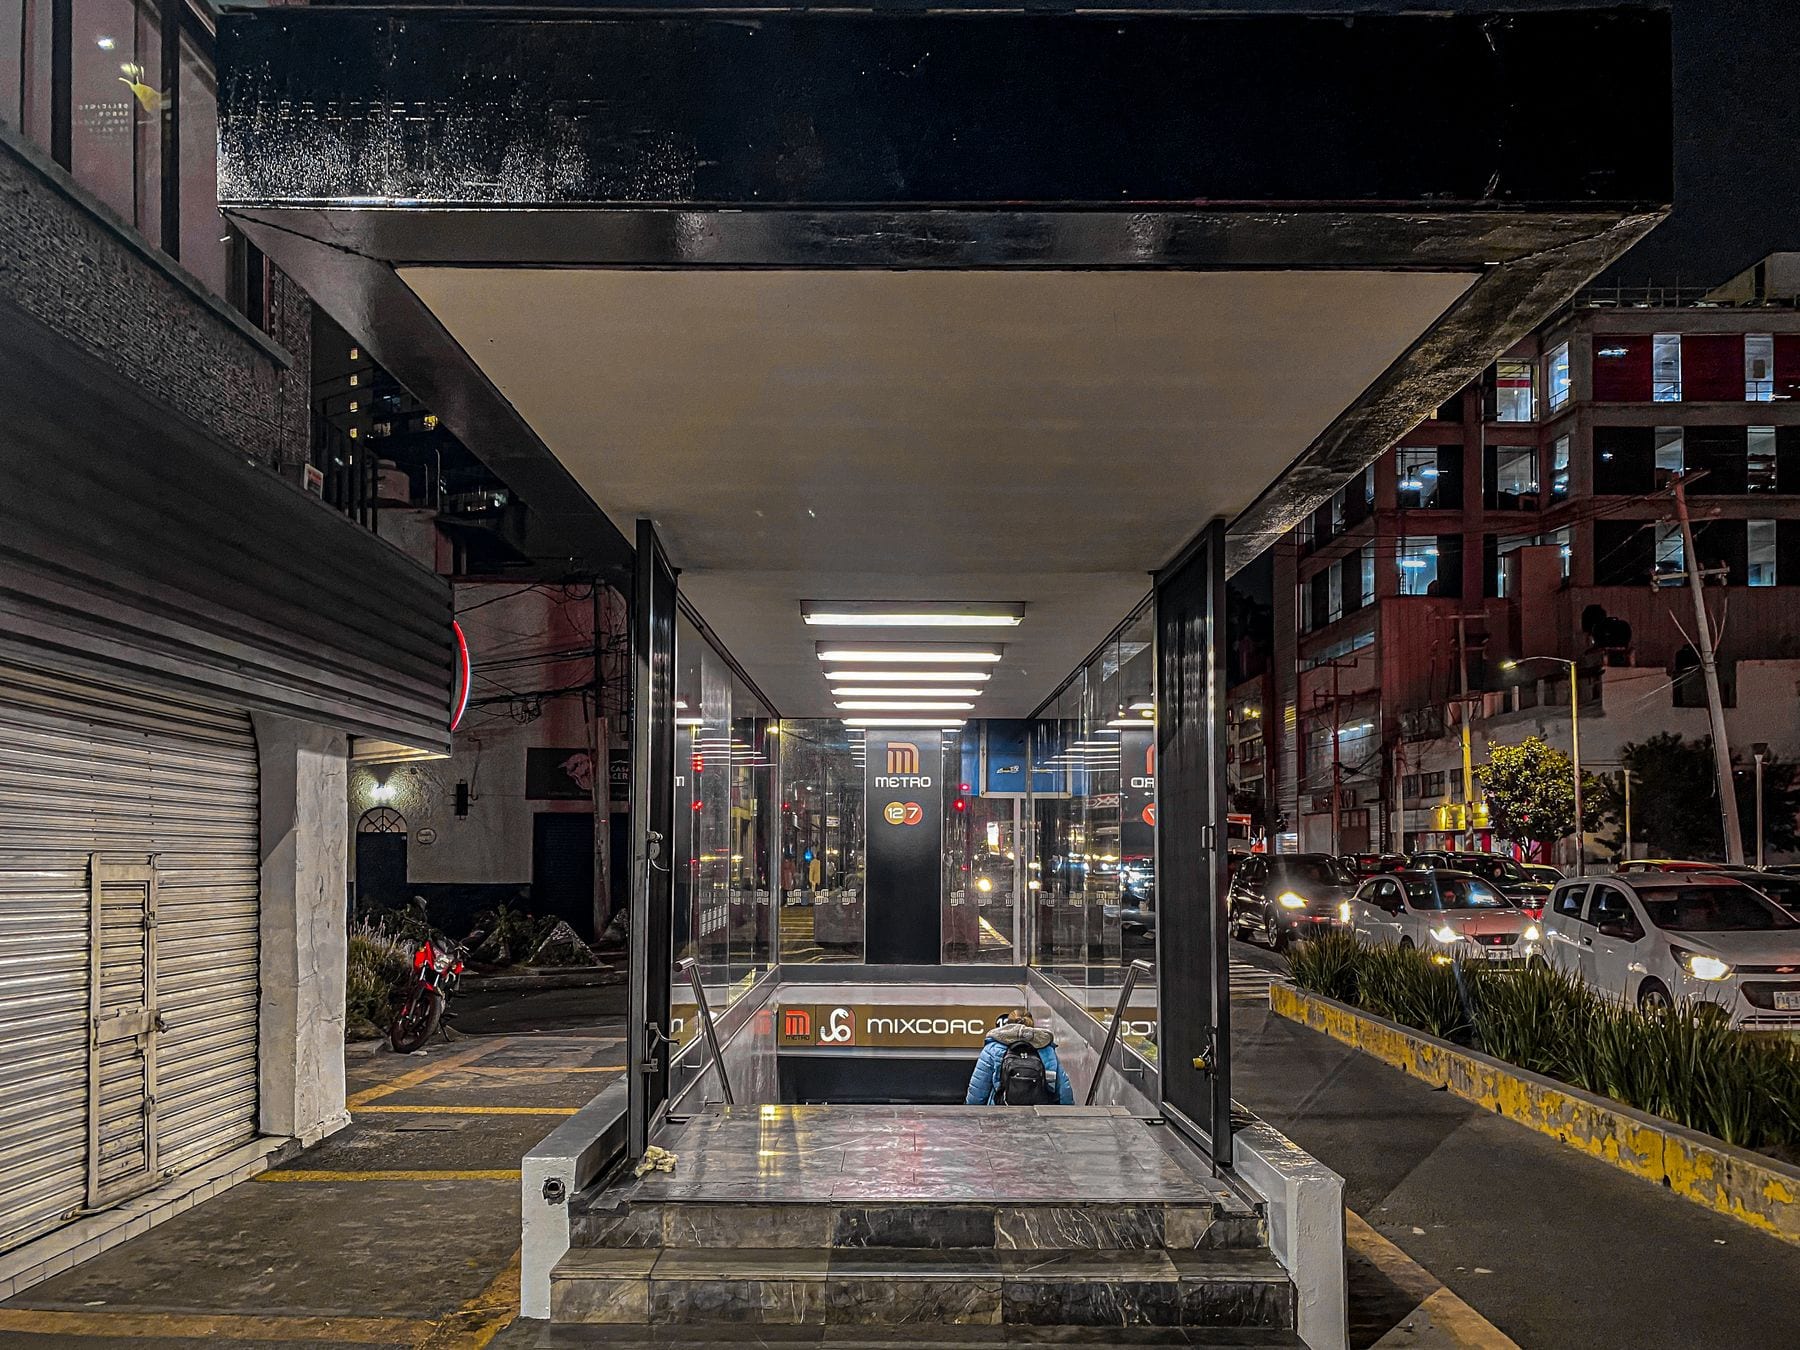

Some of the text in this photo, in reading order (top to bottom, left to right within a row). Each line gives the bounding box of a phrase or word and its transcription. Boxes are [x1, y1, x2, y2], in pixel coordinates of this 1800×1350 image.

[875, 776, 932, 788] METRO
[887, 807, 919, 819] 12 7
[867, 1019, 984, 1034] MIXCOAC
